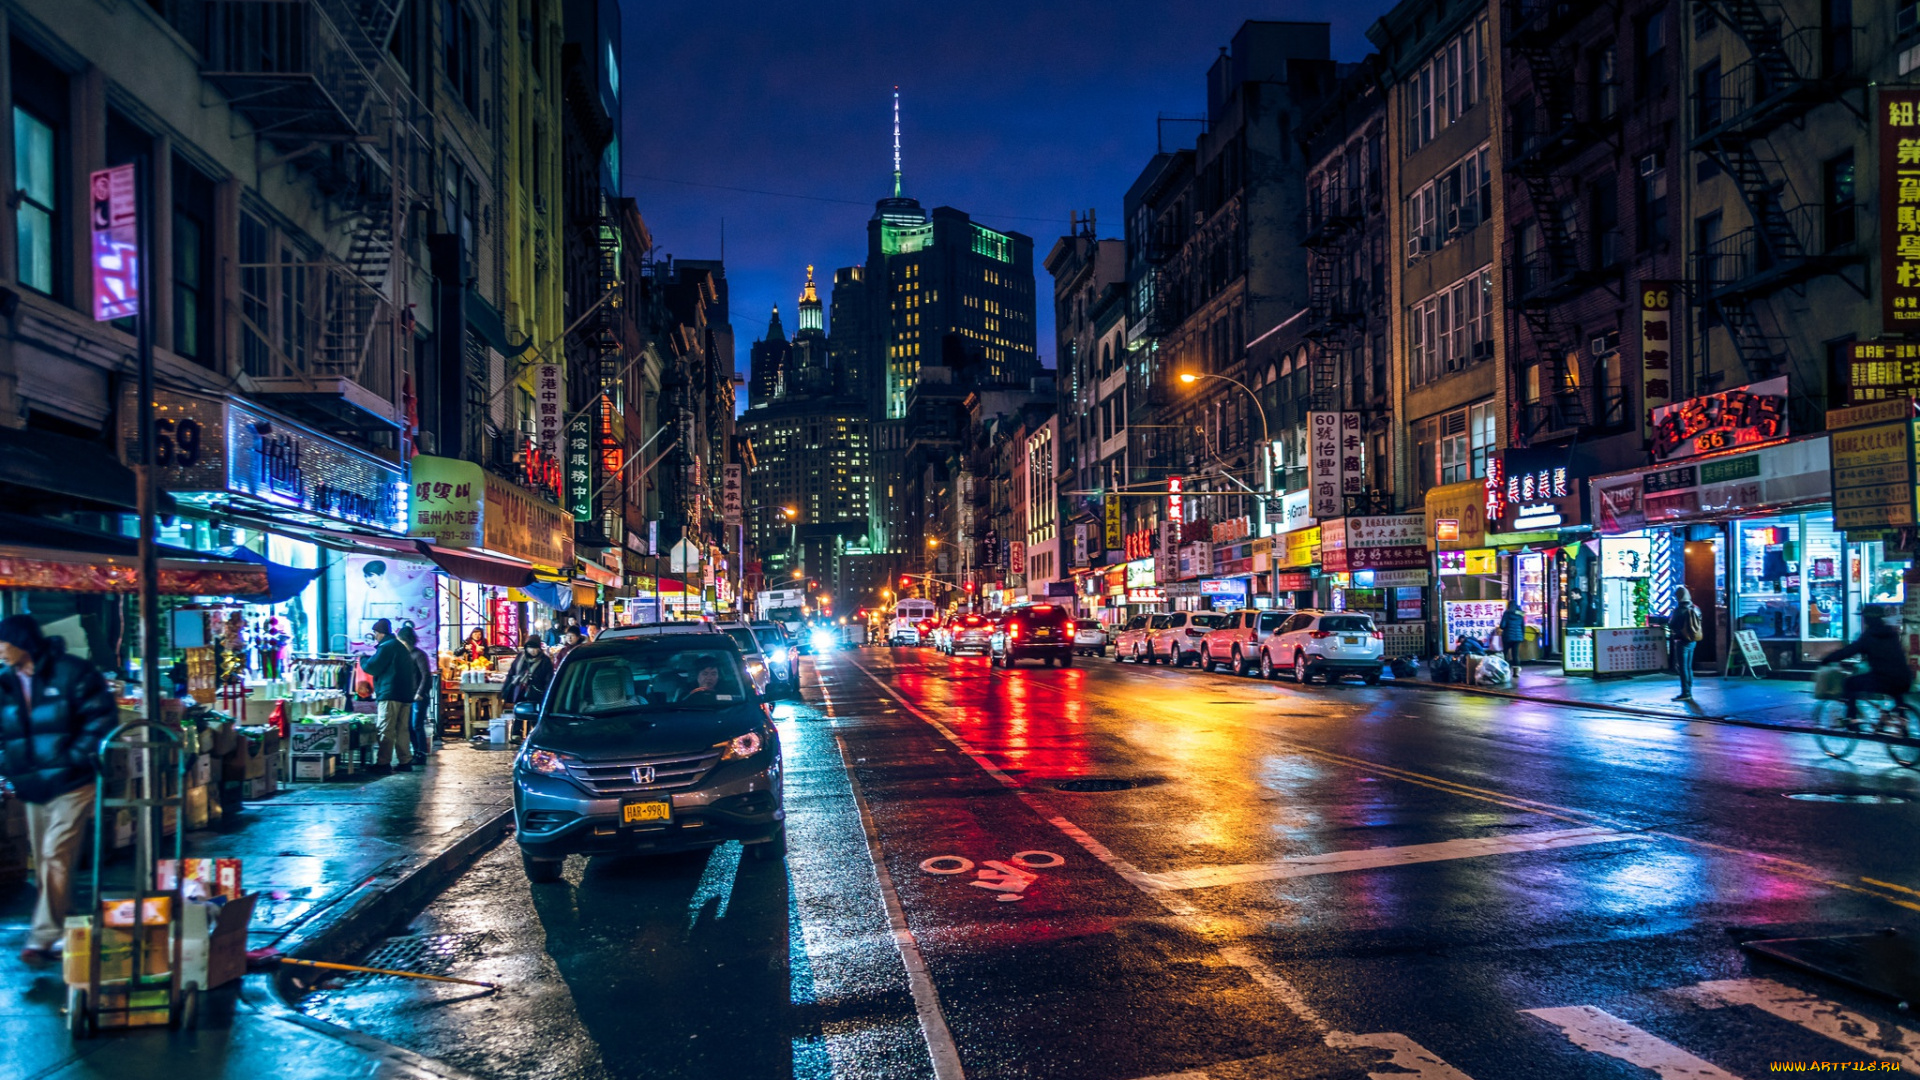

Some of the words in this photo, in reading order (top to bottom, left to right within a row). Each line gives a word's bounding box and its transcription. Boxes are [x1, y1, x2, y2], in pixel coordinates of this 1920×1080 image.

[1889, 102, 1920, 126] 紐
[1644, 291, 1668, 307] 66
[154, 419, 199, 466] 69
[1698, 431, 1724, 450] 66
[570, 420, 588, 515] 欣榕服務中心
[418, 510, 478, 525] 福州小吃店
[293, 727, 336, 752] Vegetables
